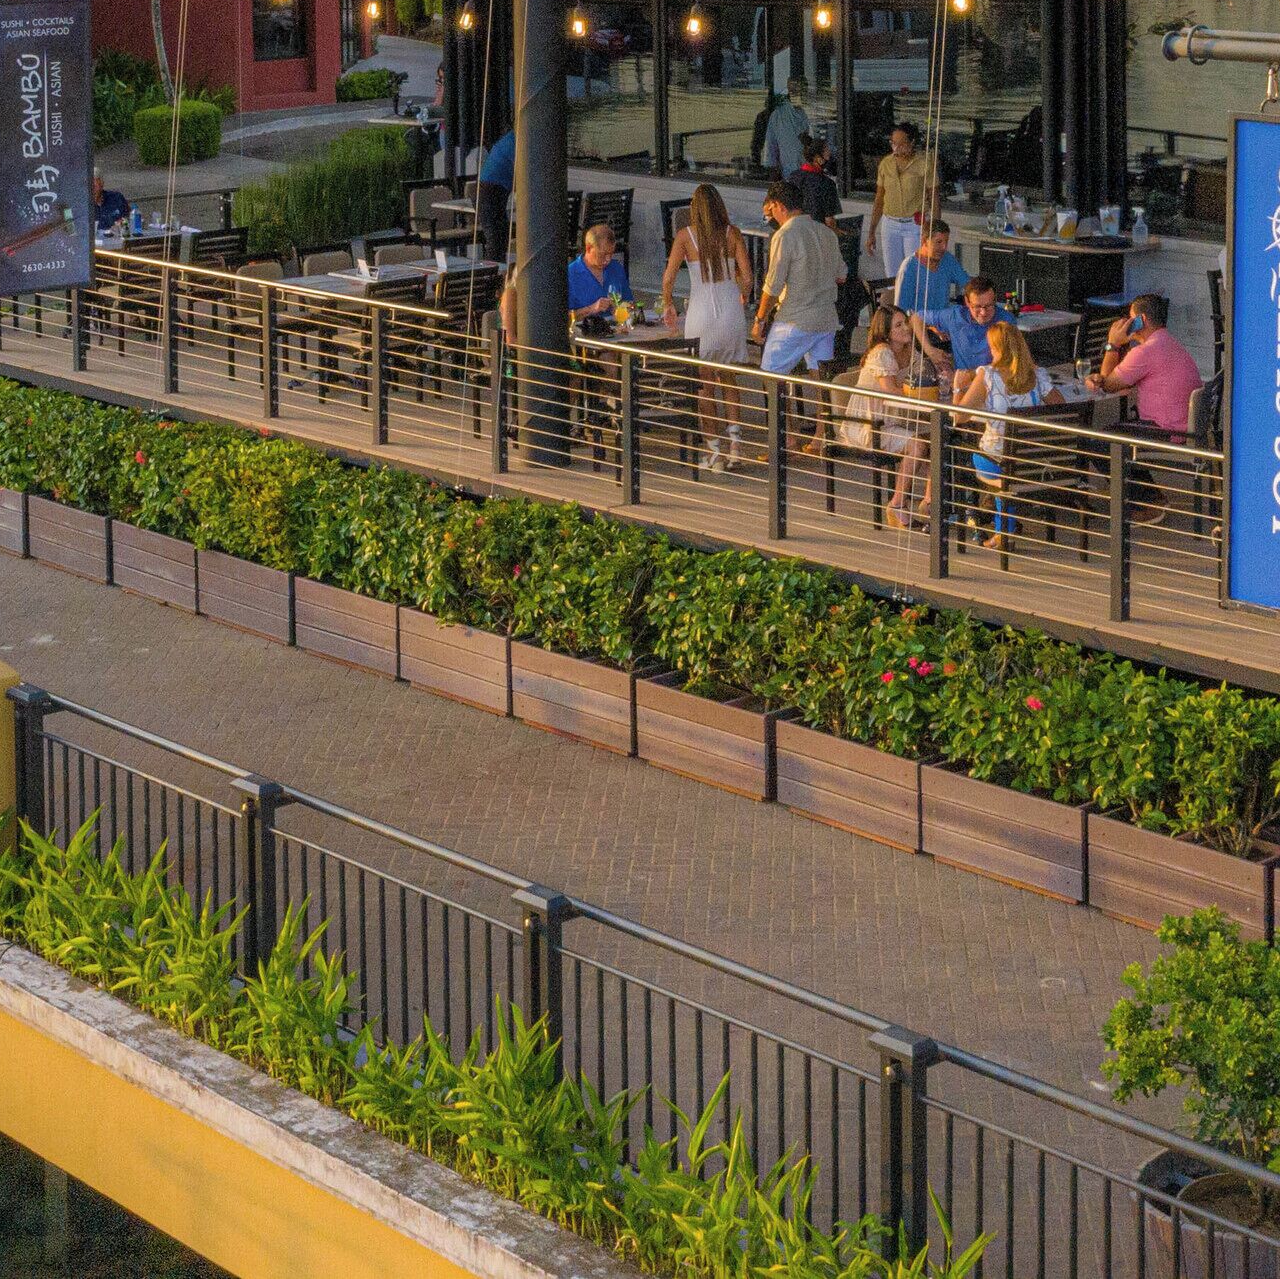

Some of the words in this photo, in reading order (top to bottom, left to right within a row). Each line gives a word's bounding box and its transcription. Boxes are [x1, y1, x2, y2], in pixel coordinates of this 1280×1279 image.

[0, 20, 24, 29] SUSHI
[32, 16, 75, 27] COCKTAILS
[6, 29, 31, 39] ASIAN
[32, 27, 70, 37] SEAFOOD
[50, 61, 62, 97] ASIAN
[17, 54, 44, 158] BAMBÚ
[51, 112, 63, 146] SUSHI
